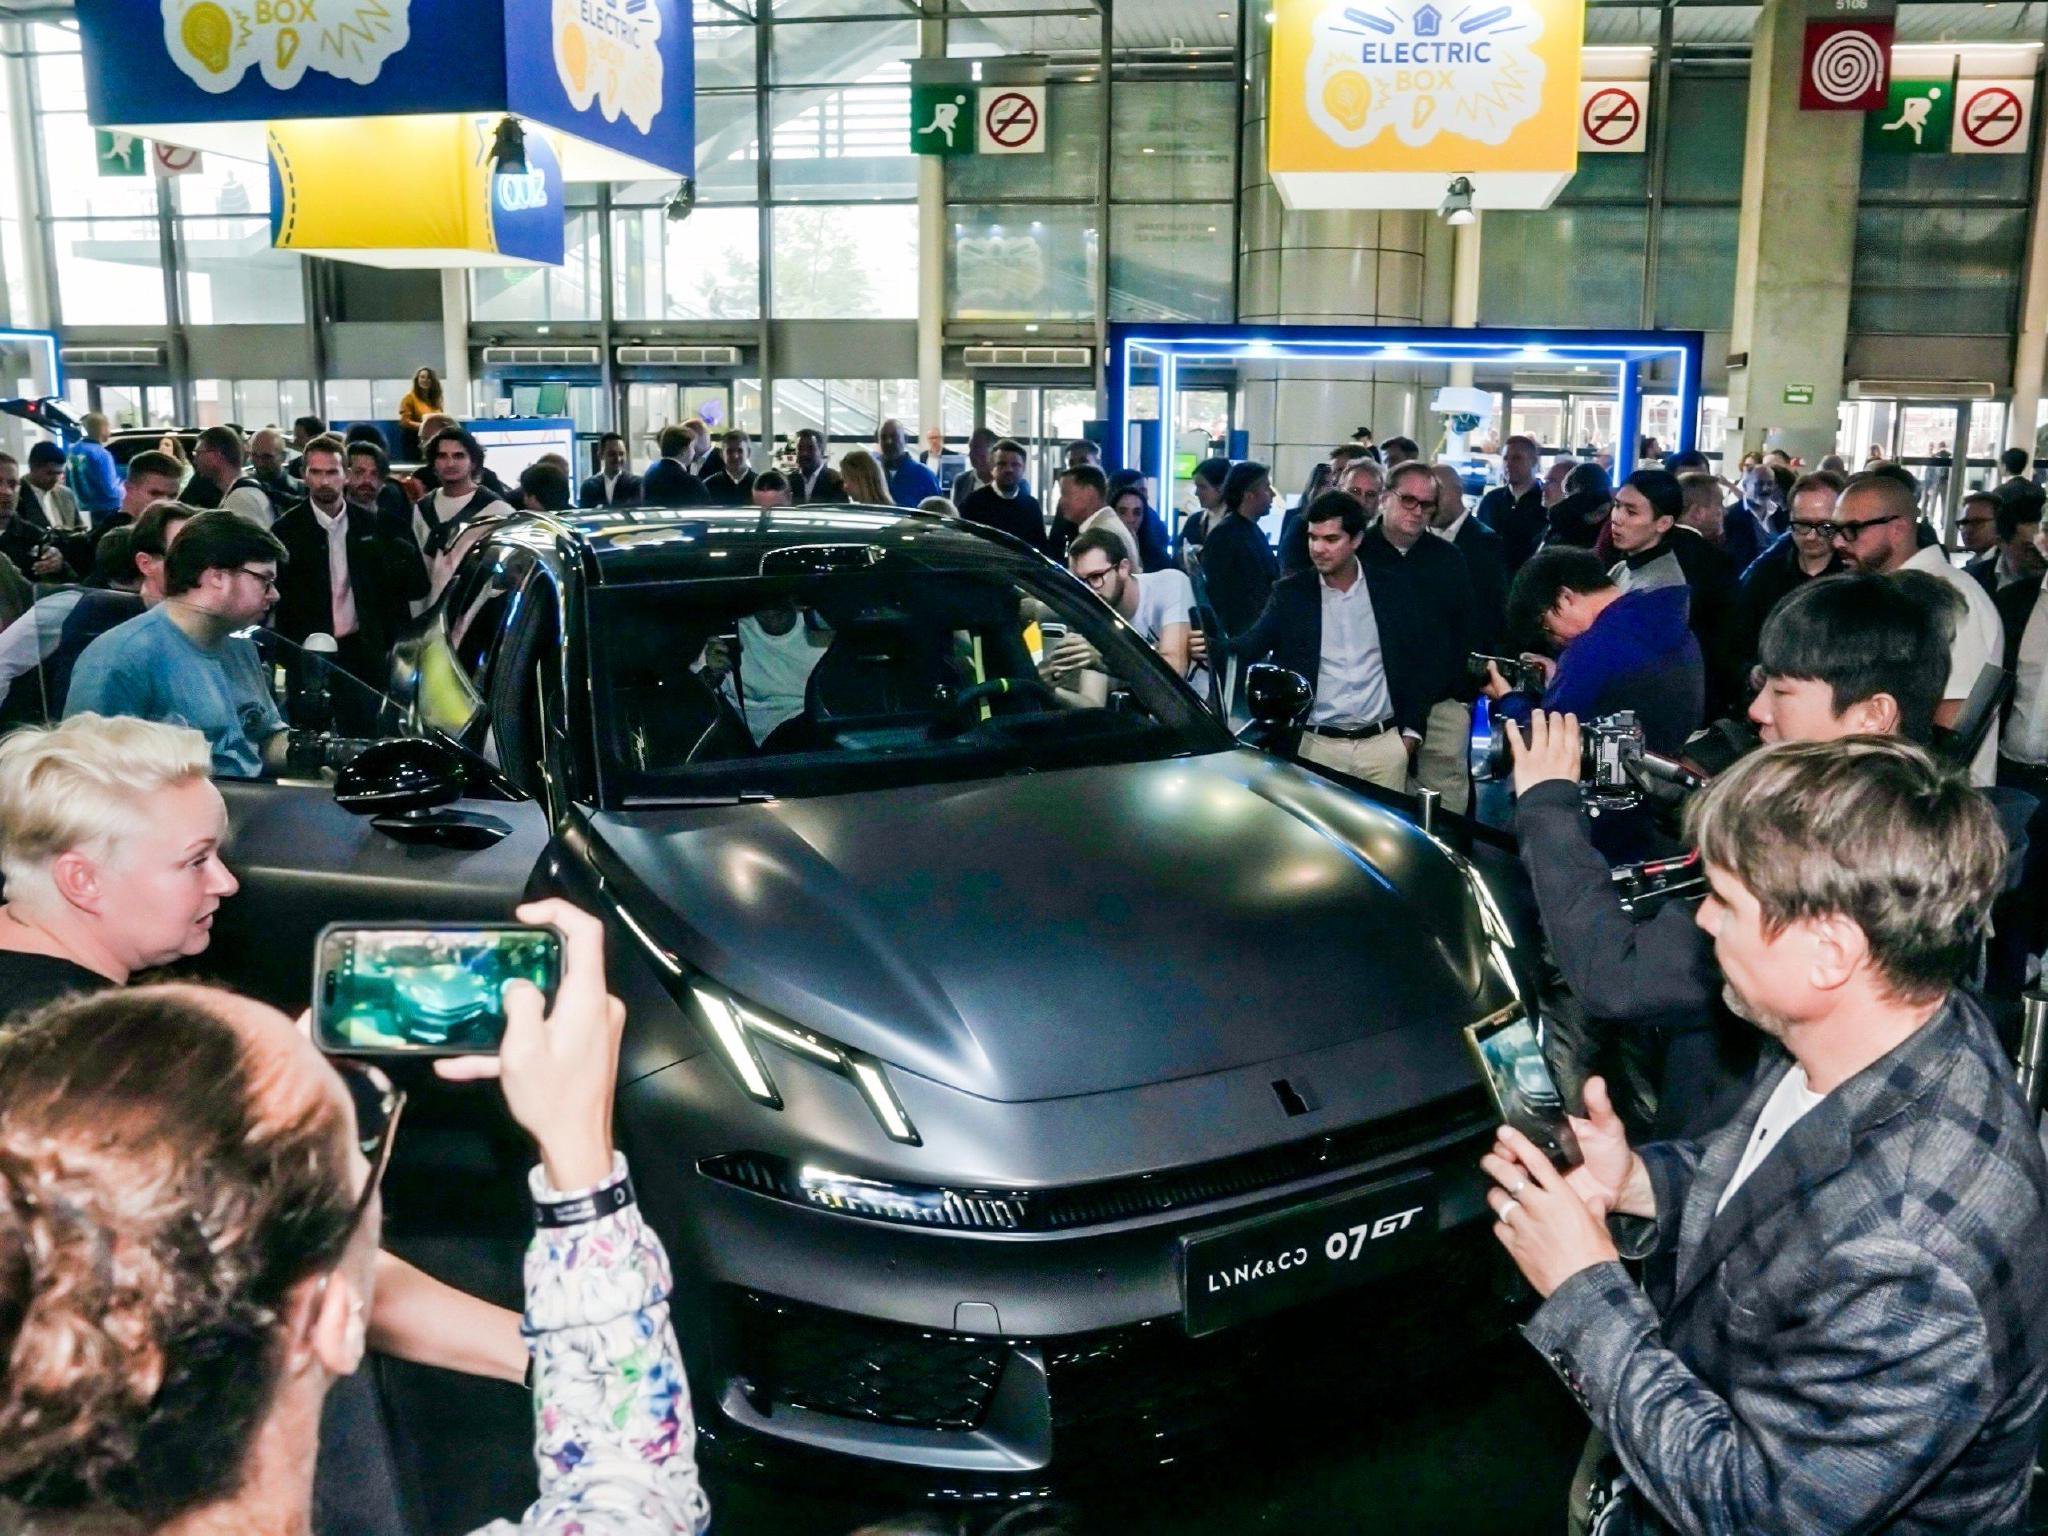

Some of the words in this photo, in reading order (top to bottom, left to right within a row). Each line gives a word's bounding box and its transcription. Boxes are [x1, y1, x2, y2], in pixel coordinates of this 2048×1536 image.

[256, 0, 317, 24] BOX
[580, 0, 641, 49] ELECTRIC
[1362, 42, 1492, 64] ELECTRIC
[1396, 70, 1456, 92] BOX
[1208, 1247, 1308, 1293] LYNK&CO
[1325, 1223, 1368, 1261] 07
[1370, 1206, 1424, 1239] GT
